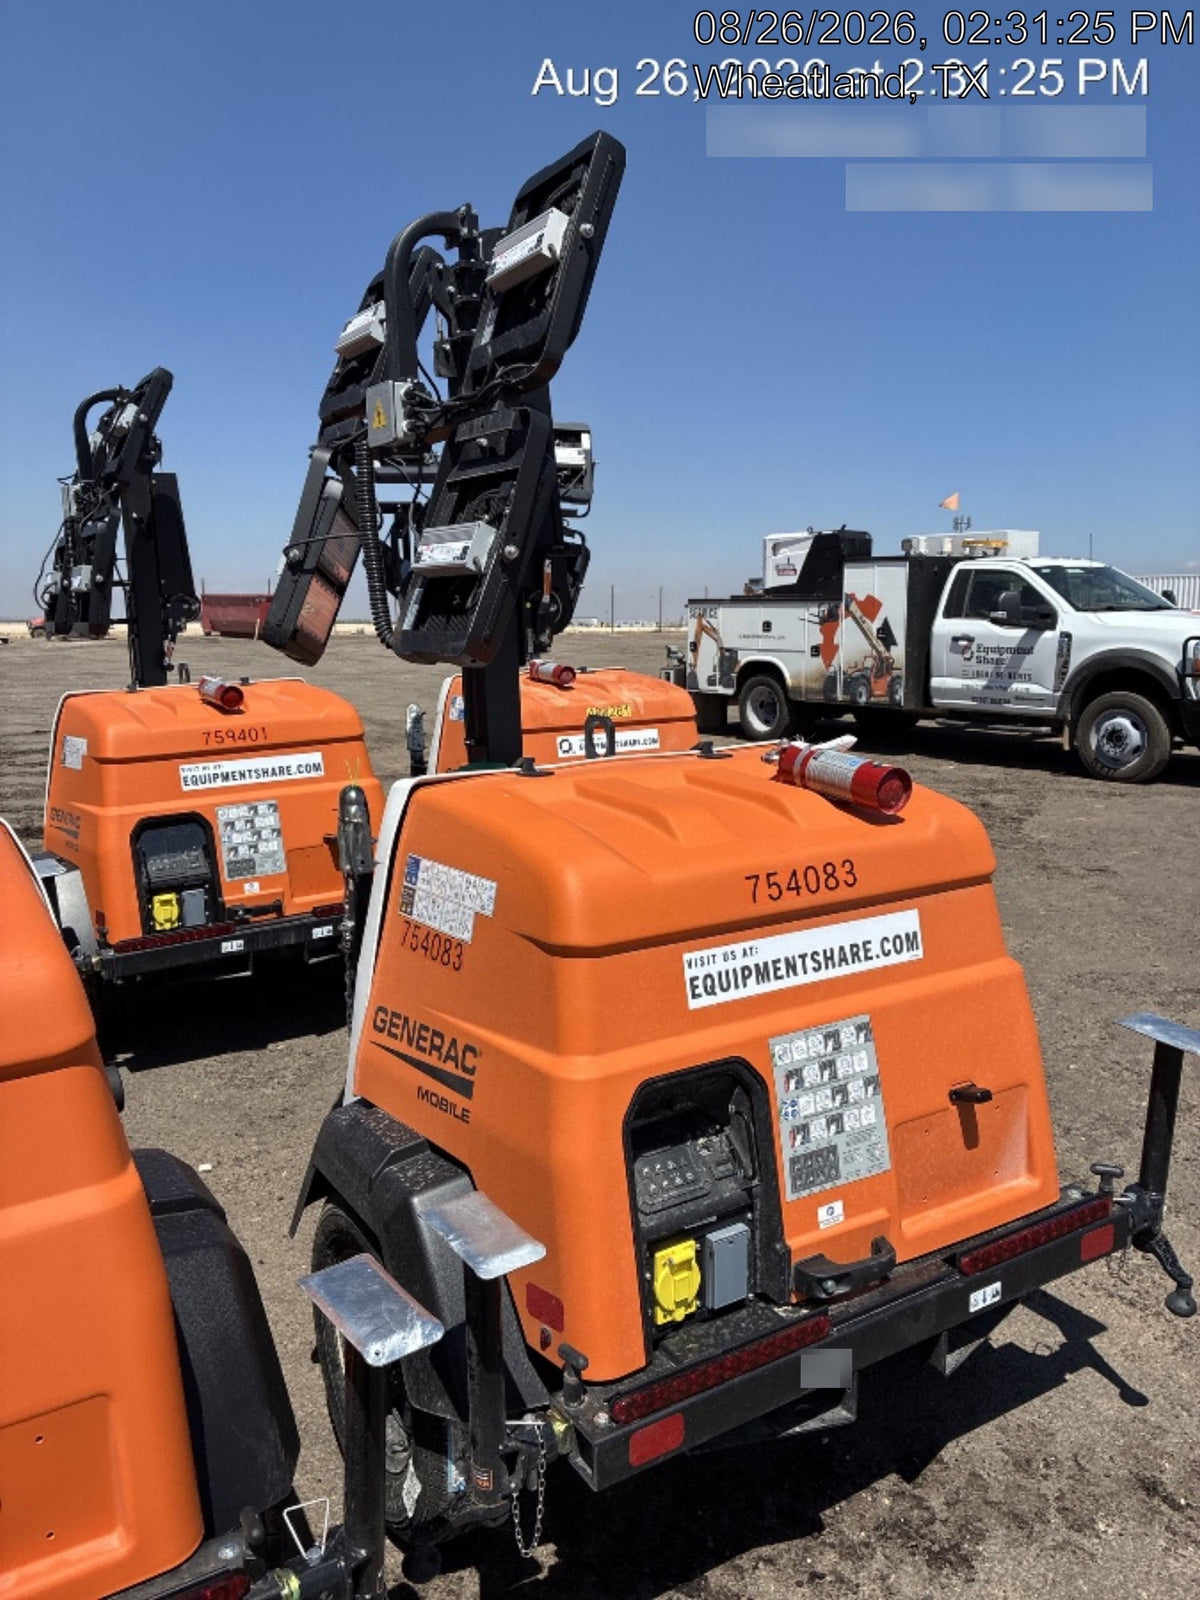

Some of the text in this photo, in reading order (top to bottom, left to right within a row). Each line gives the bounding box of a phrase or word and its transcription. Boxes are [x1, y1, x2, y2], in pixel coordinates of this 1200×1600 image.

[202, 727, 268, 745] 759401
[183, 762, 322, 787] EQUIPMENTSHARE.COM
[744, 859, 858, 904] 754083
[401, 920, 464, 972] 754083
[686, 945, 759, 969] VISIT US AT:
[688, 931, 920, 1000] EQUIPMENTSHARE.COM
[372, 1005, 478, 1076] GENERAC
[416, 1086, 471, 1124] MOBILE
